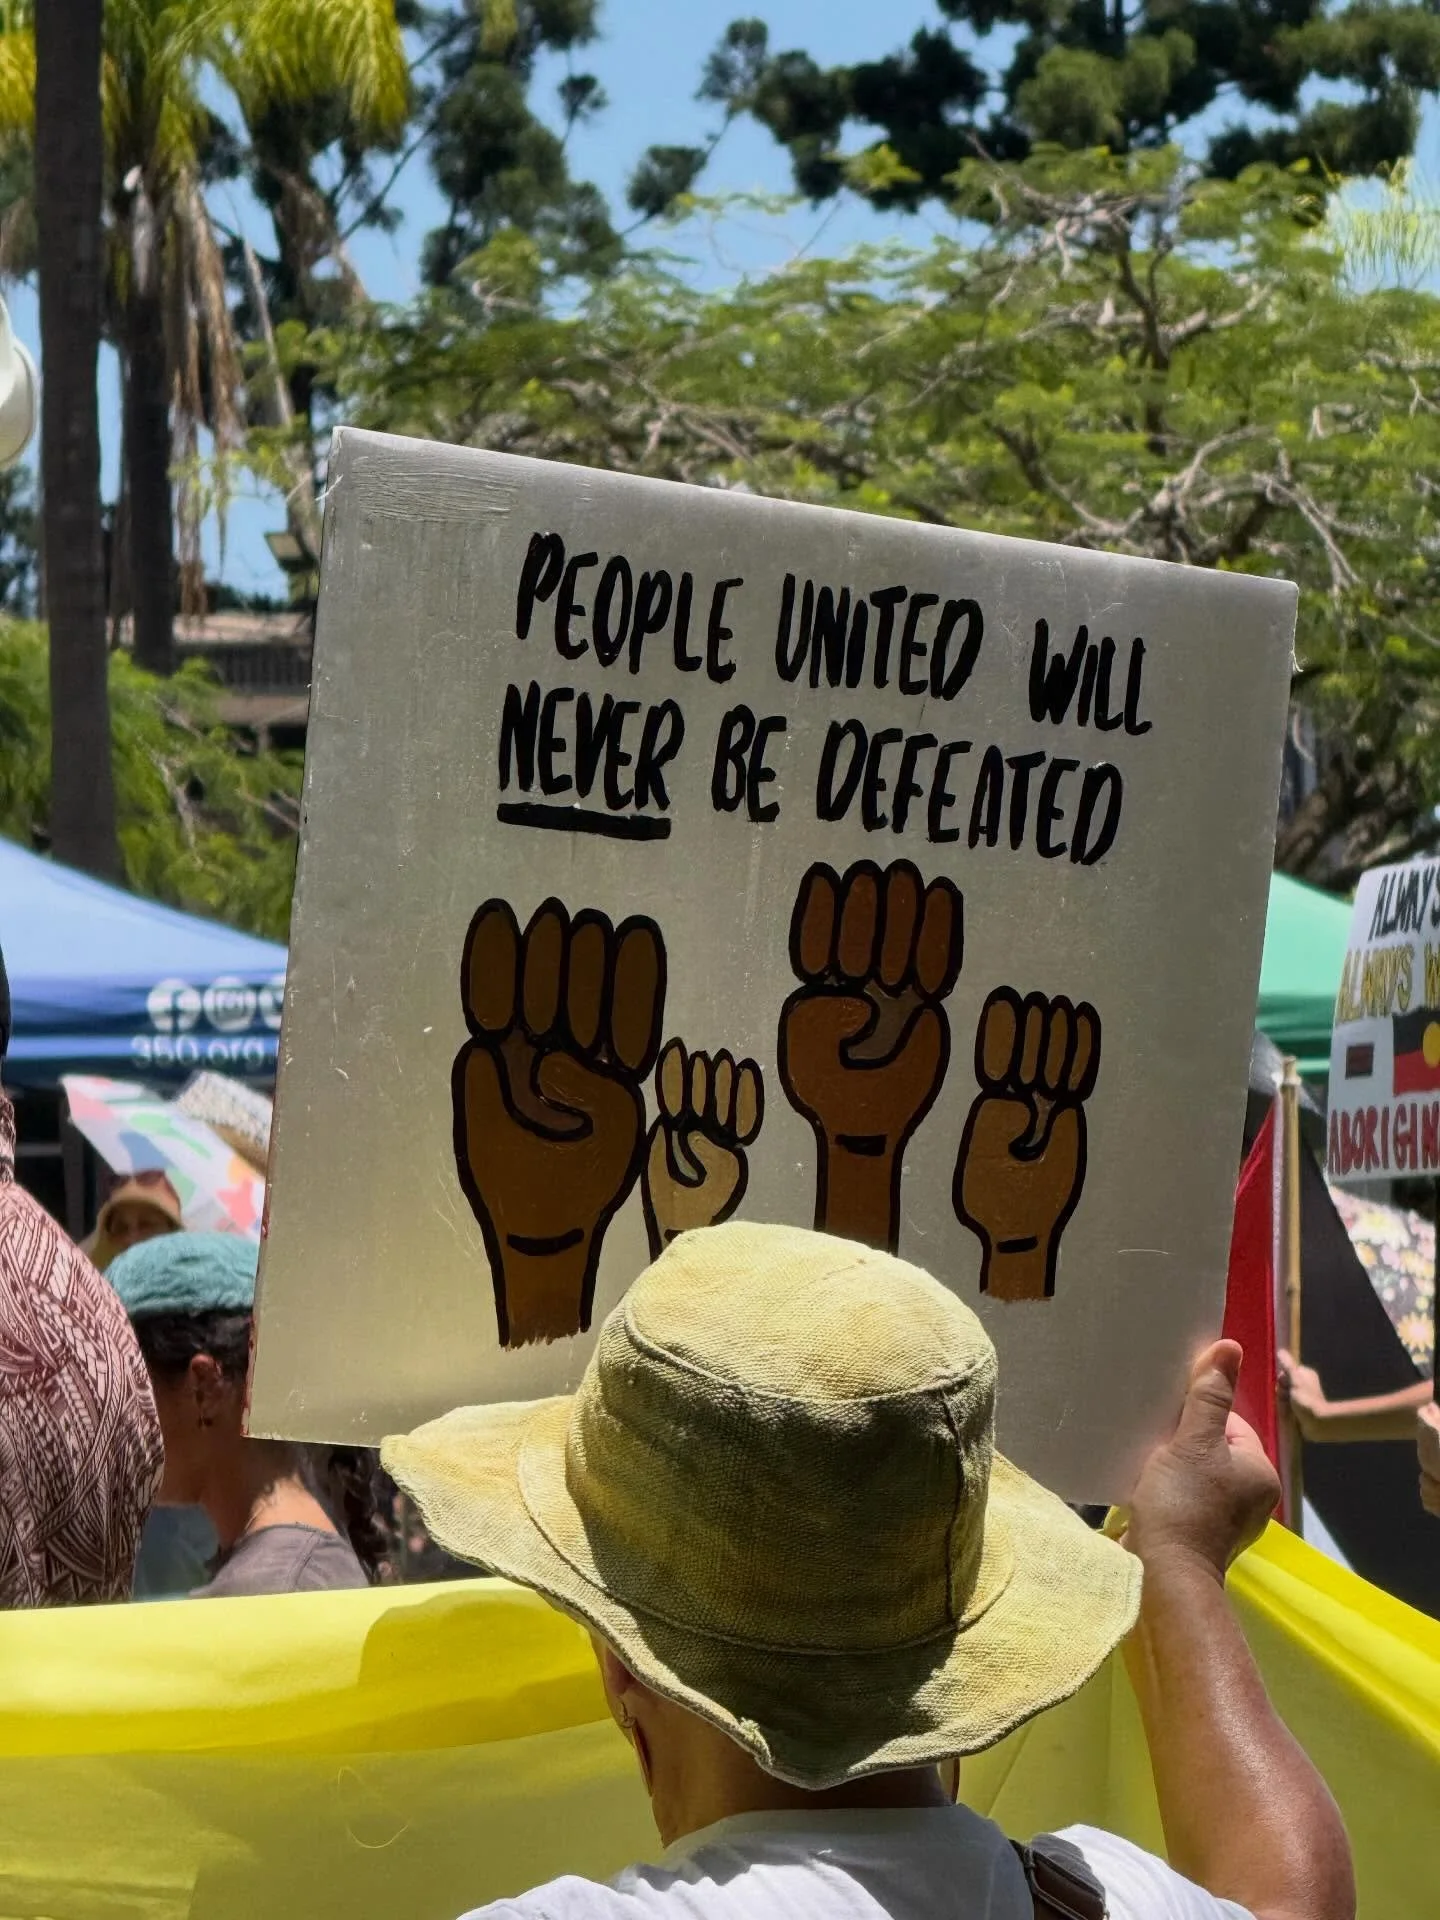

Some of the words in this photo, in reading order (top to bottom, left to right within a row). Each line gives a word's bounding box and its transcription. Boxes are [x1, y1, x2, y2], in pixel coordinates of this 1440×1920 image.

[516, 531, 744, 684] PEOPLE
[775, 573, 984, 700] UNITED
[1029, 618, 1153, 736] WILL
[499, 680, 685, 811] NEVER
[711, 703, 787, 822] BE
[816, 718, 1123, 866] DEFEATED
